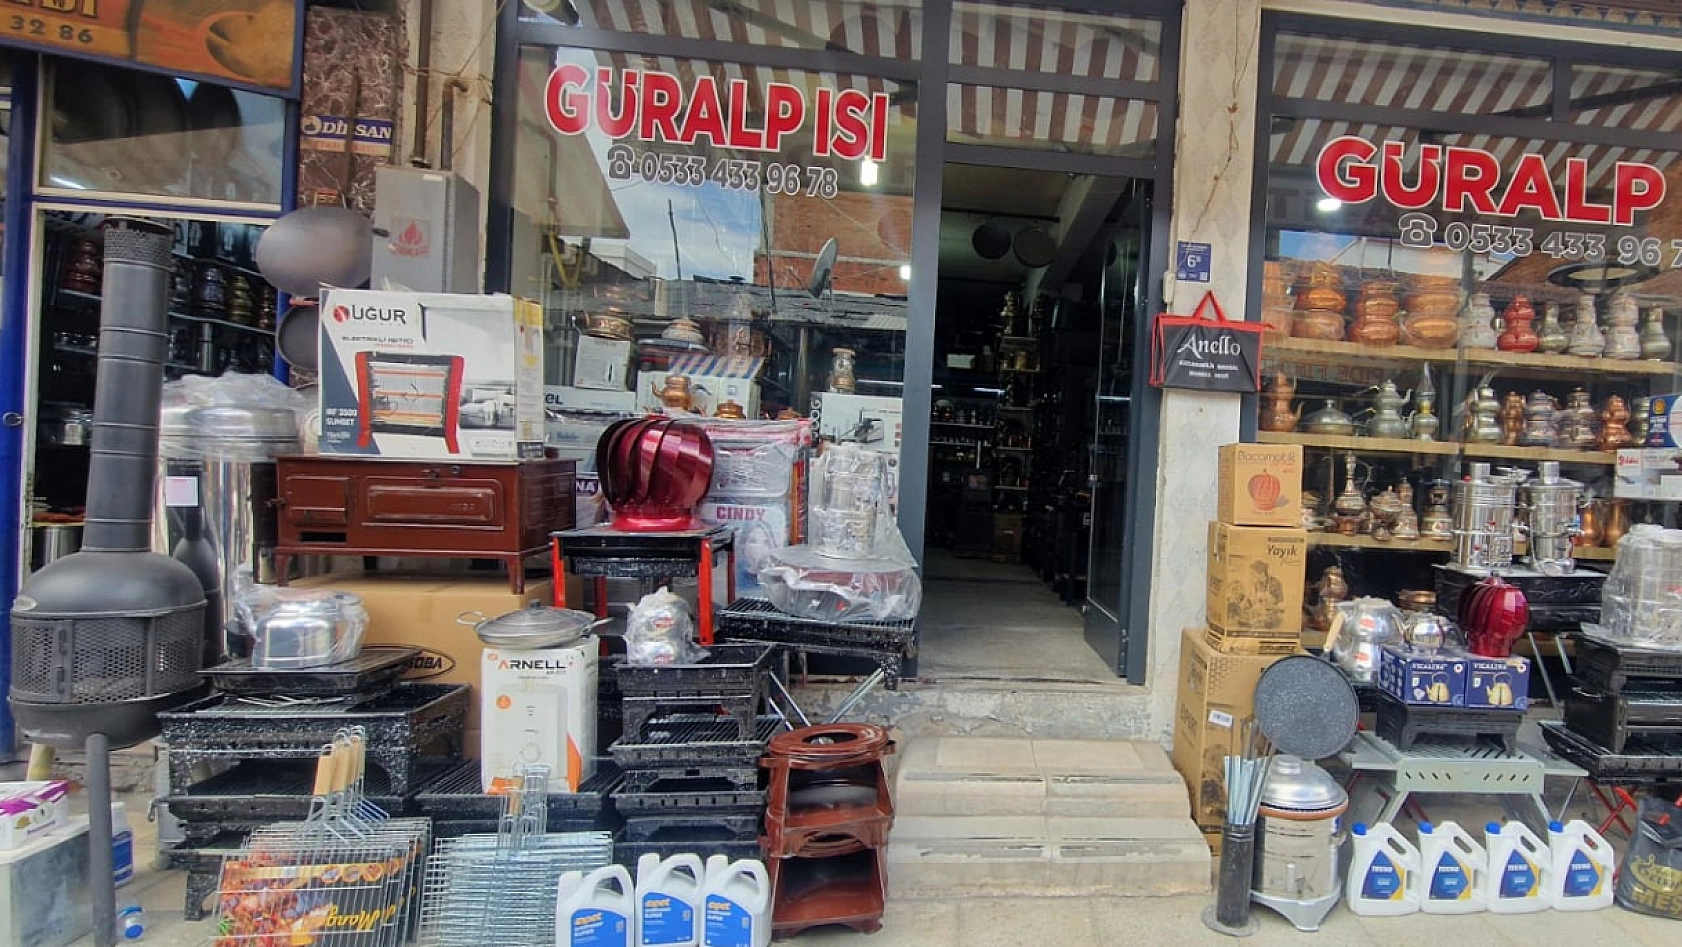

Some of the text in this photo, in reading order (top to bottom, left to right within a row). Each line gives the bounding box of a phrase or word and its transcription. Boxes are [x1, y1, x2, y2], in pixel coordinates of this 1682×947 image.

[59, 24, 93, 43] 86
[544, 64, 890, 161] GÜRALP ISI
[640, 152, 838, 199] 0533 433 96 78
[1316, 134, 1666, 226] GÜRALP
[1444, 222, 1534, 255] 0533
[1540, 231, 1607, 262] 433
[1617, 235, 1662, 266] 96
[352, 305, 406, 324] UĞUR
[1177, 334, 1240, 360] Anello
[716, 506, 765, 521] CINDY
[499, 660, 568, 669] ARNELL
